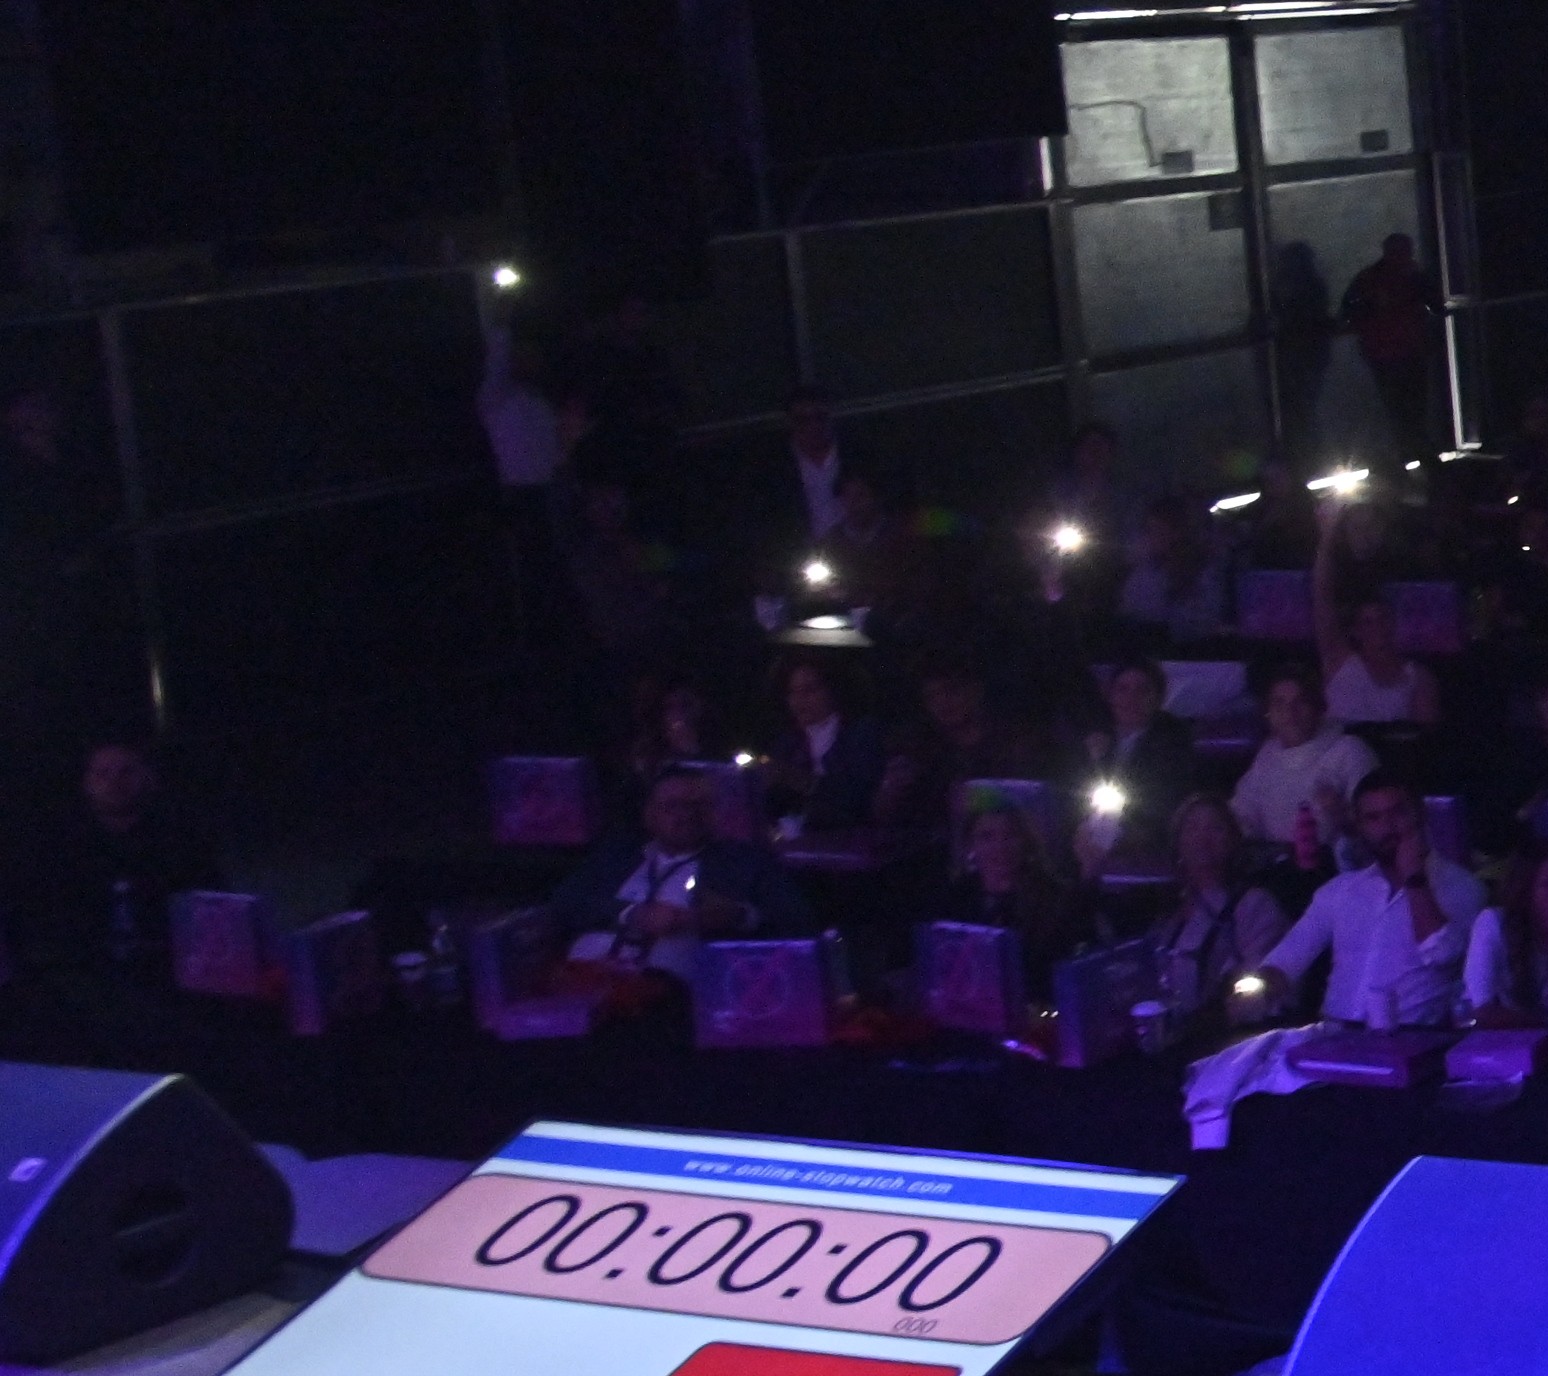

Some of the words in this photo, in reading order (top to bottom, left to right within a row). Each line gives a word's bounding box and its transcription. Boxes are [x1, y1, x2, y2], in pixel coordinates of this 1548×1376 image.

[683, 1160, 953, 1195] www.online-stopwatch.com
[475, 1194, 1003, 1312] 00:00:00
[893, 1316, 939, 1334] 000
